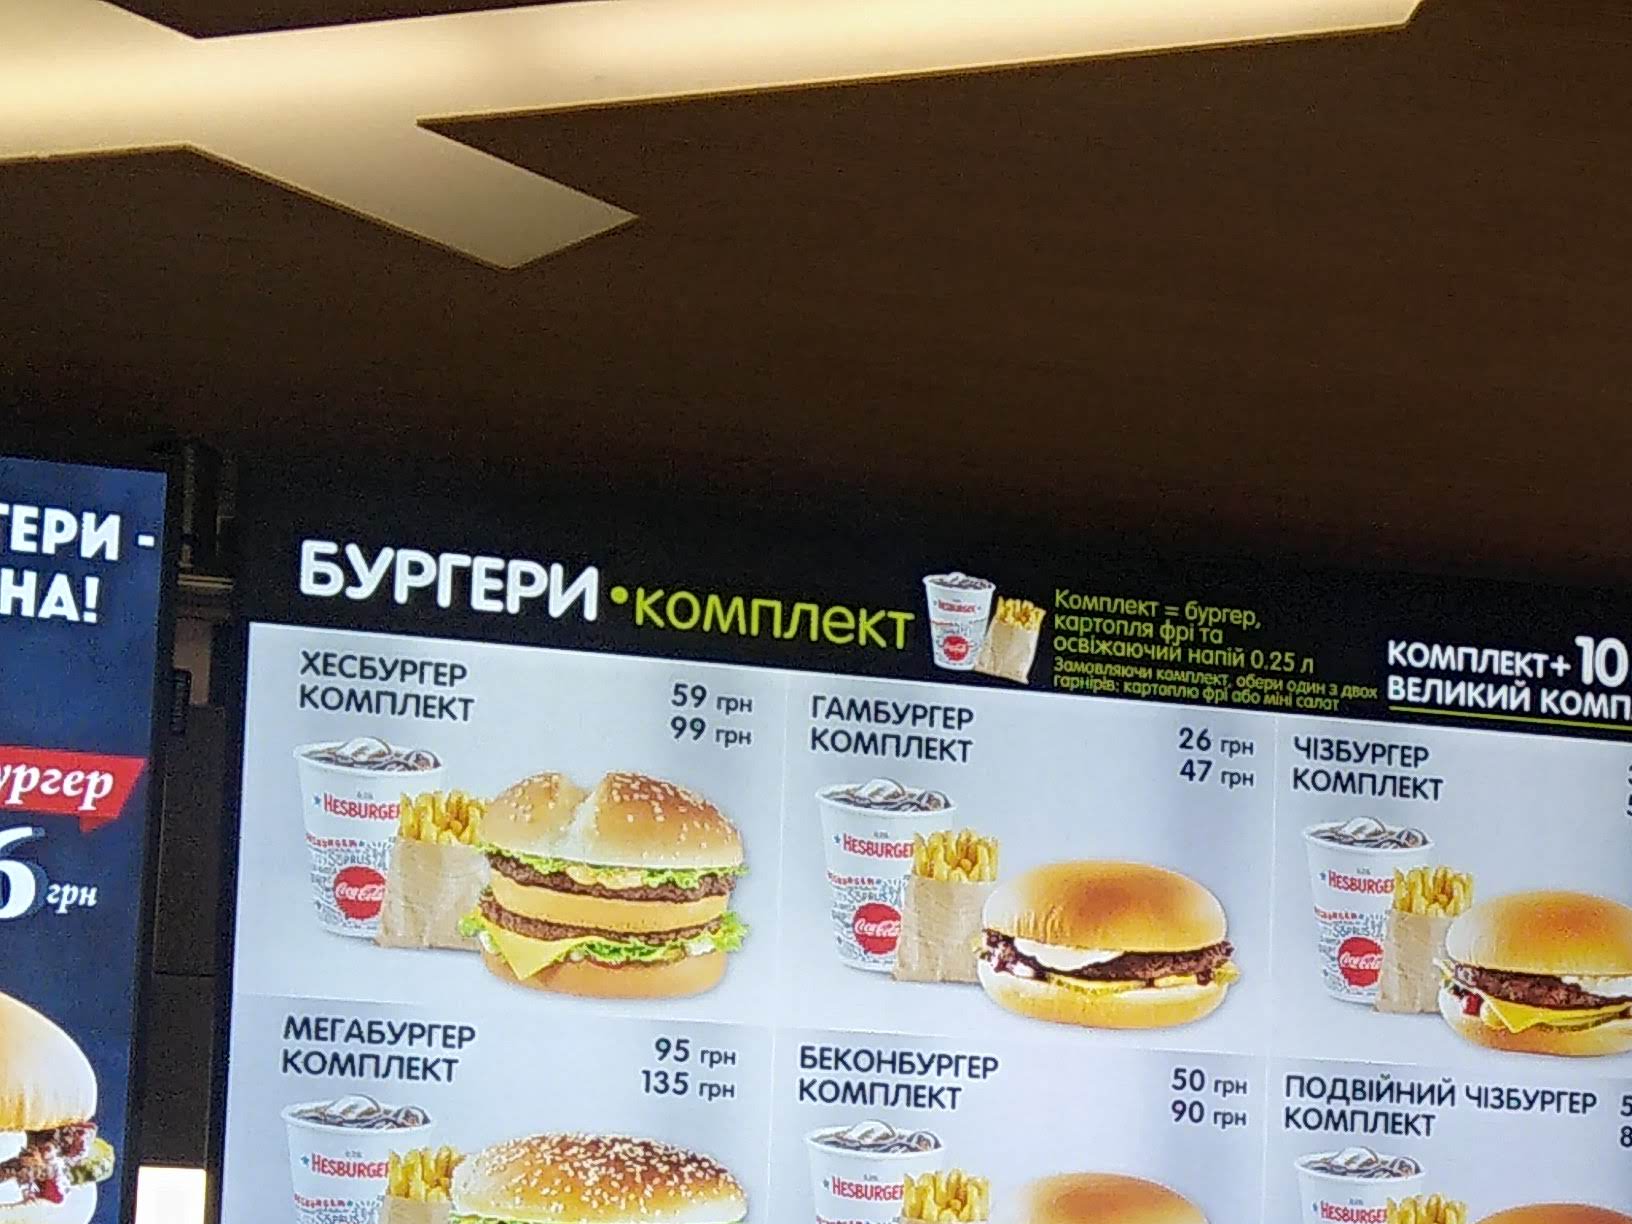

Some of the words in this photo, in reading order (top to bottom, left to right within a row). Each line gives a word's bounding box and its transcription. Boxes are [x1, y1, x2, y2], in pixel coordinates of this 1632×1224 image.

[301, 540, 598, 621] БУРГЕРИ
[633, 586, 914, 649] комплект
[1055, 589, 1159, 617] Комплект
[1185, 601, 1261, 629] бургер,
[1055, 614, 1153, 637] картопля
[1160, 623, 1195, 646] фрі
[1202, 627, 1223, 644] та
[300, 651, 467, 688] ХЕСБУРГЕР
[1054, 636, 1181, 662] освіжаючий
[1188, 648, 1244, 669] напій
[1251, 650, 1295, 672] 0.25
[1575, 636, 1628, 687] 10
[299, 685, 474, 722] КОМПЛЕКТ
[672, 682, 705, 708] 59
[716, 695, 753, 715] грн
[1387, 675, 1531, 712] ВЕЛИКИЙ
[812, 695, 975, 731] ГАМБУРГЕР
[670, 716, 704, 742] 99
[715, 728, 752, 748] грн
[810, 728, 974, 764] КОМПЛЕКТ
[1178, 728, 1212, 752] 26
[1221, 738, 1254, 757] грн
[1293, 736, 1430, 768] ЧІЗБУРГЕР
[1179, 759, 1212, 784] 47
[1221, 769, 1254, 789] грн
[1292, 768, 1444, 801] КОМПЛЕКТ
[285, 1015, 476, 1049] МЕГАБУРГЕР
[282, 1049, 459, 1083] КОМПЛЕКТ
[654, 1038, 690, 1064] 95
[700, 1049, 736, 1068] грн
[800, 1045, 999, 1080] БЕКОНБУРГЕР
[640, 1069, 689, 1096] 135
[699, 1080, 735, 1101] грн
[799, 1077, 962, 1111] КОМПЛЕКТ
[1172, 1068, 1205, 1093] 50
[1213, 1077, 1248, 1097] грн
[1286, 1074, 1455, 1106] ПОДВІЙНИЙ
[1466, 1085, 1597, 1115] ЧІЗБУРГЕР
[1171, 1099, 1205, 1124] 90
[1213, 1109, 1247, 1129] грн
[1284, 1106, 1435, 1137] КОМПЛЕКТ
